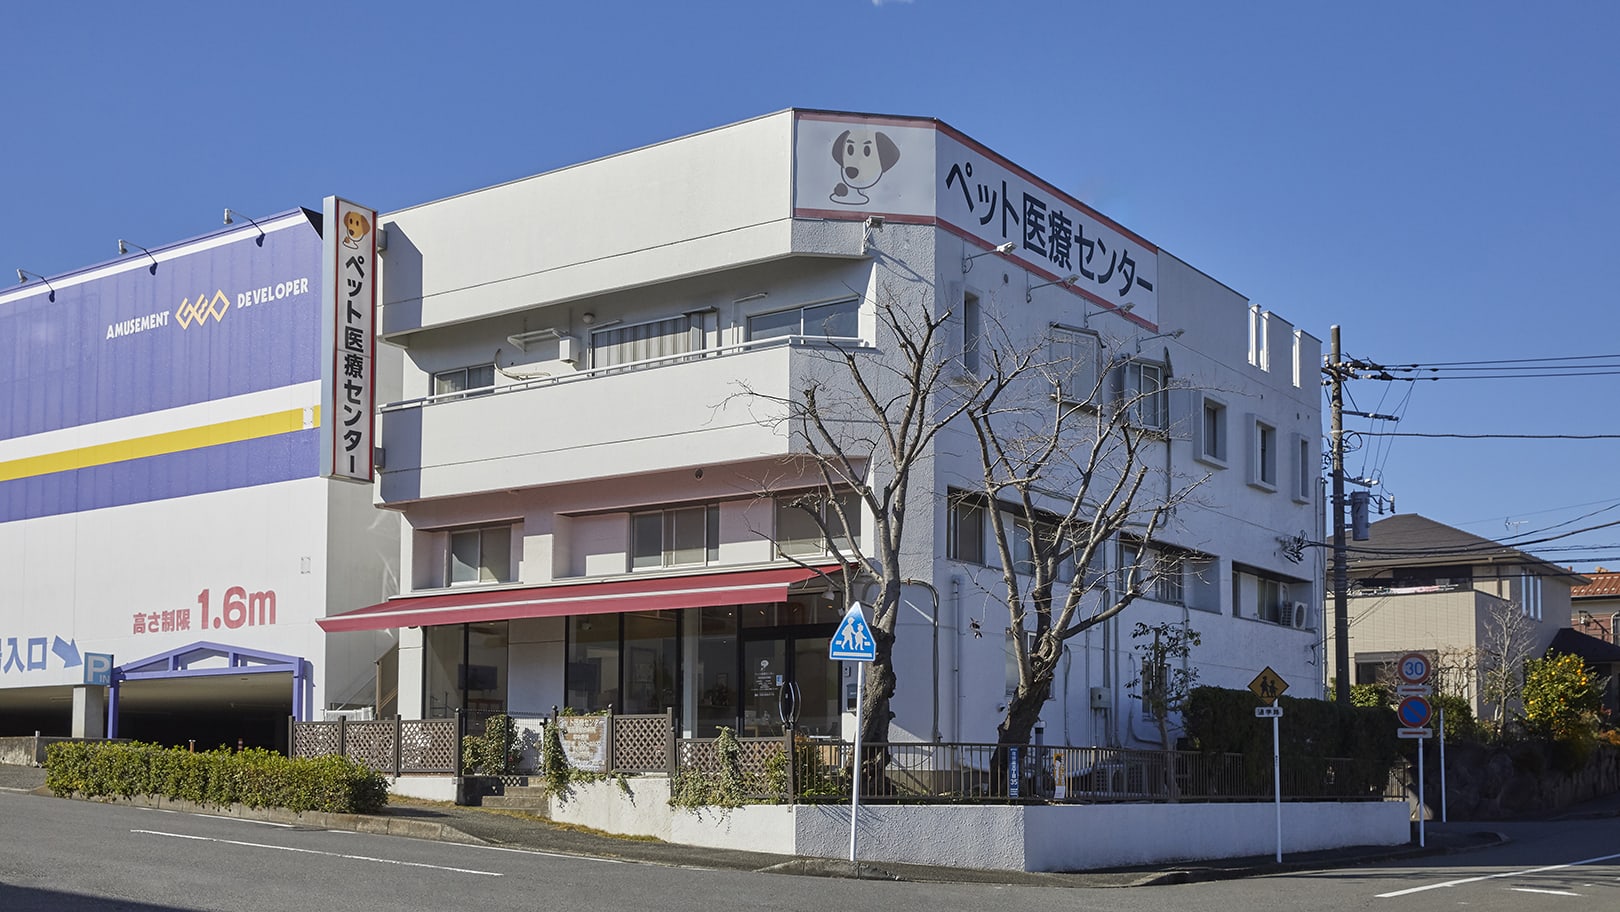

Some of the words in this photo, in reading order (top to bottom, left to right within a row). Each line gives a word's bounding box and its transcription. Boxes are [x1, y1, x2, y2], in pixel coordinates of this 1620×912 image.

[945, 161, 1154, 297] ペット医療センター
[106, 311, 170, 340] AMUSEMENT
[237, 278, 309, 309] DEVELOPER
[343, 255, 366, 473] ペット医療センター
[132, 608, 191, 634] 高さ制限
[197, 586, 277, 630] 1.6m
[0, 637, 48, 674] 入口
[1405, 661, 1424, 676] 30
